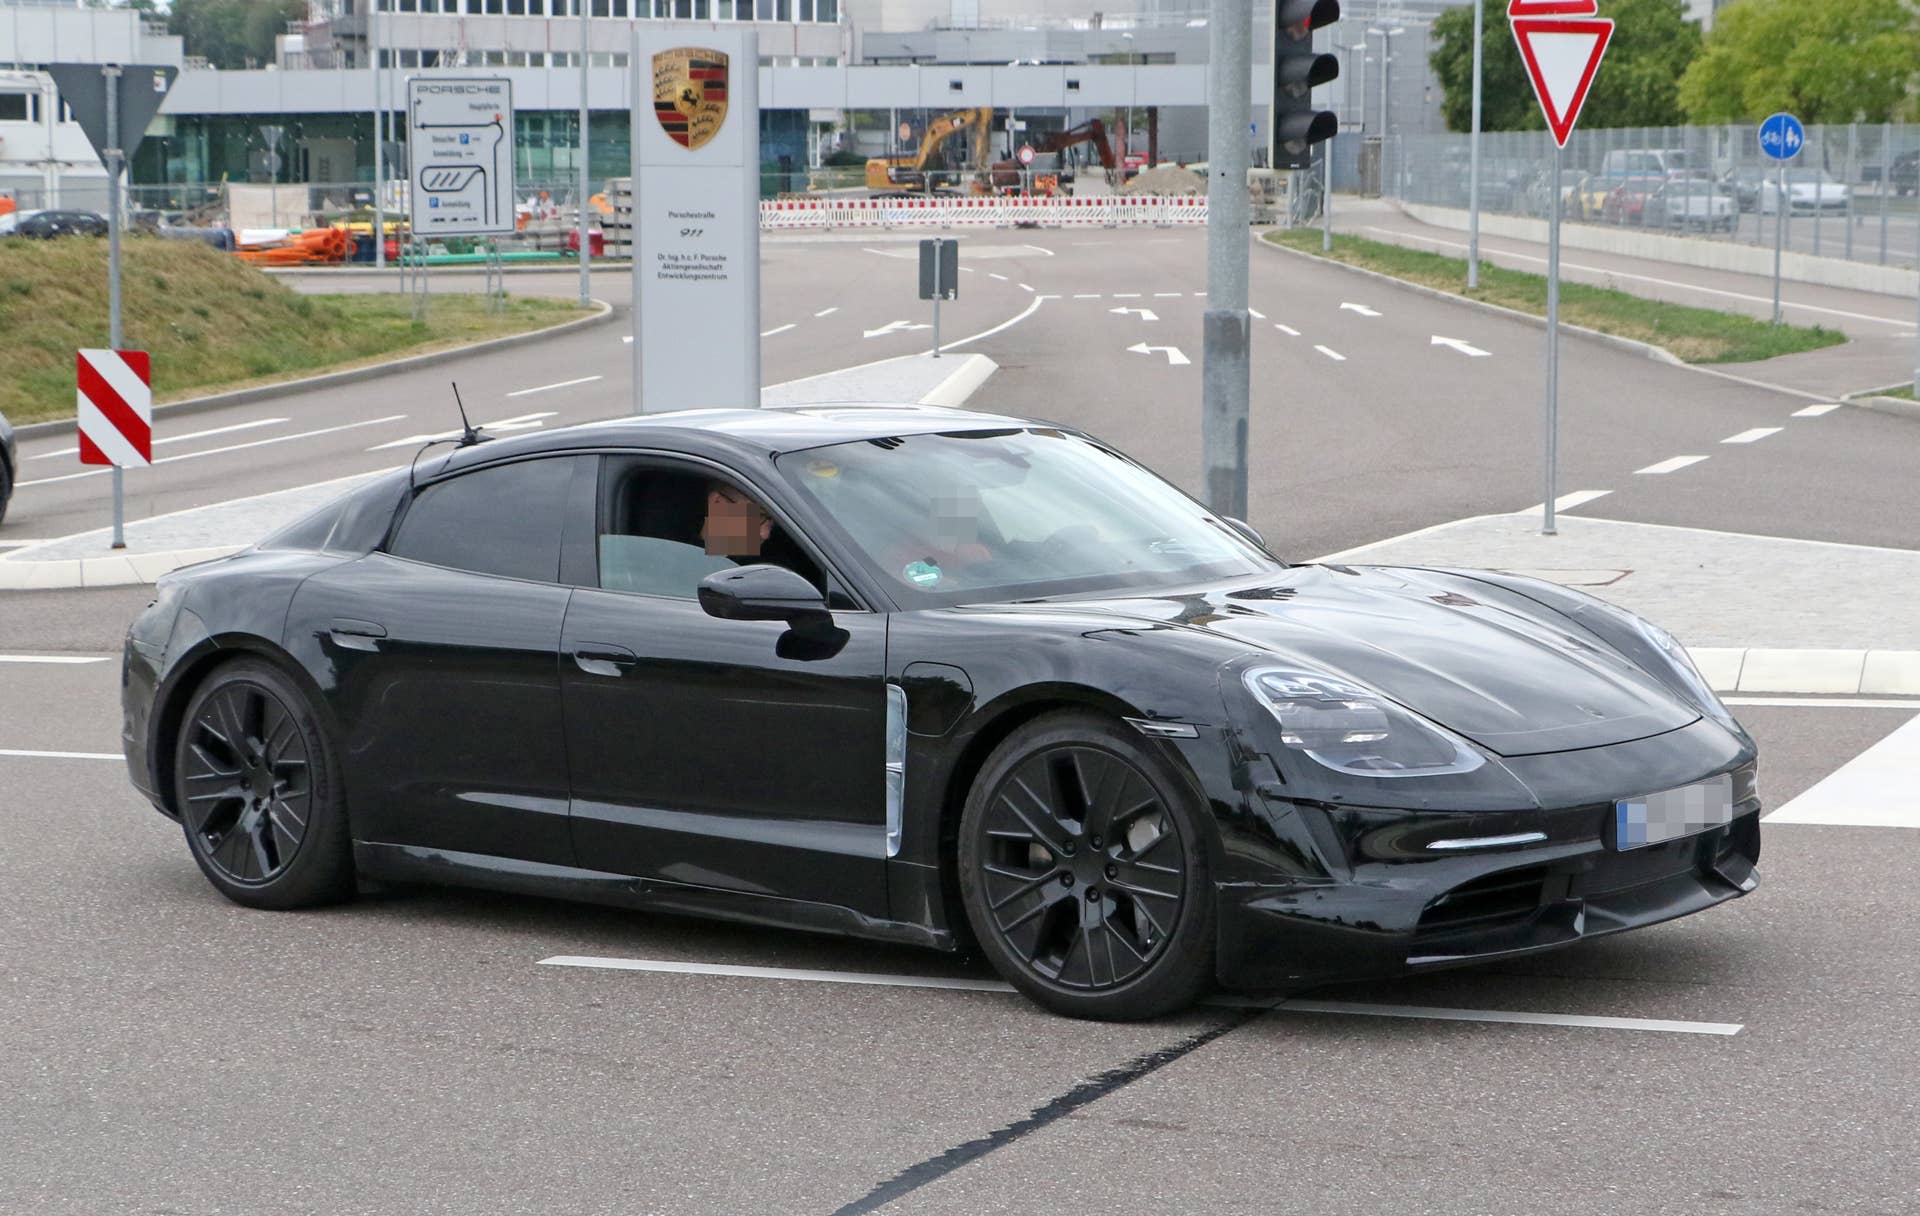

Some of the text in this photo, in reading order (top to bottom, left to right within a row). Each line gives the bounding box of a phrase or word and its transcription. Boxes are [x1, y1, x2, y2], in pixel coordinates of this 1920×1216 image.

[416, 85, 501, 94] PORSCHE
[700, 253, 727, 261] Porsche
[662, 263, 723, 271] Aktiengesellschaft
[657, 272, 728, 281] Entwicklungszentrum
